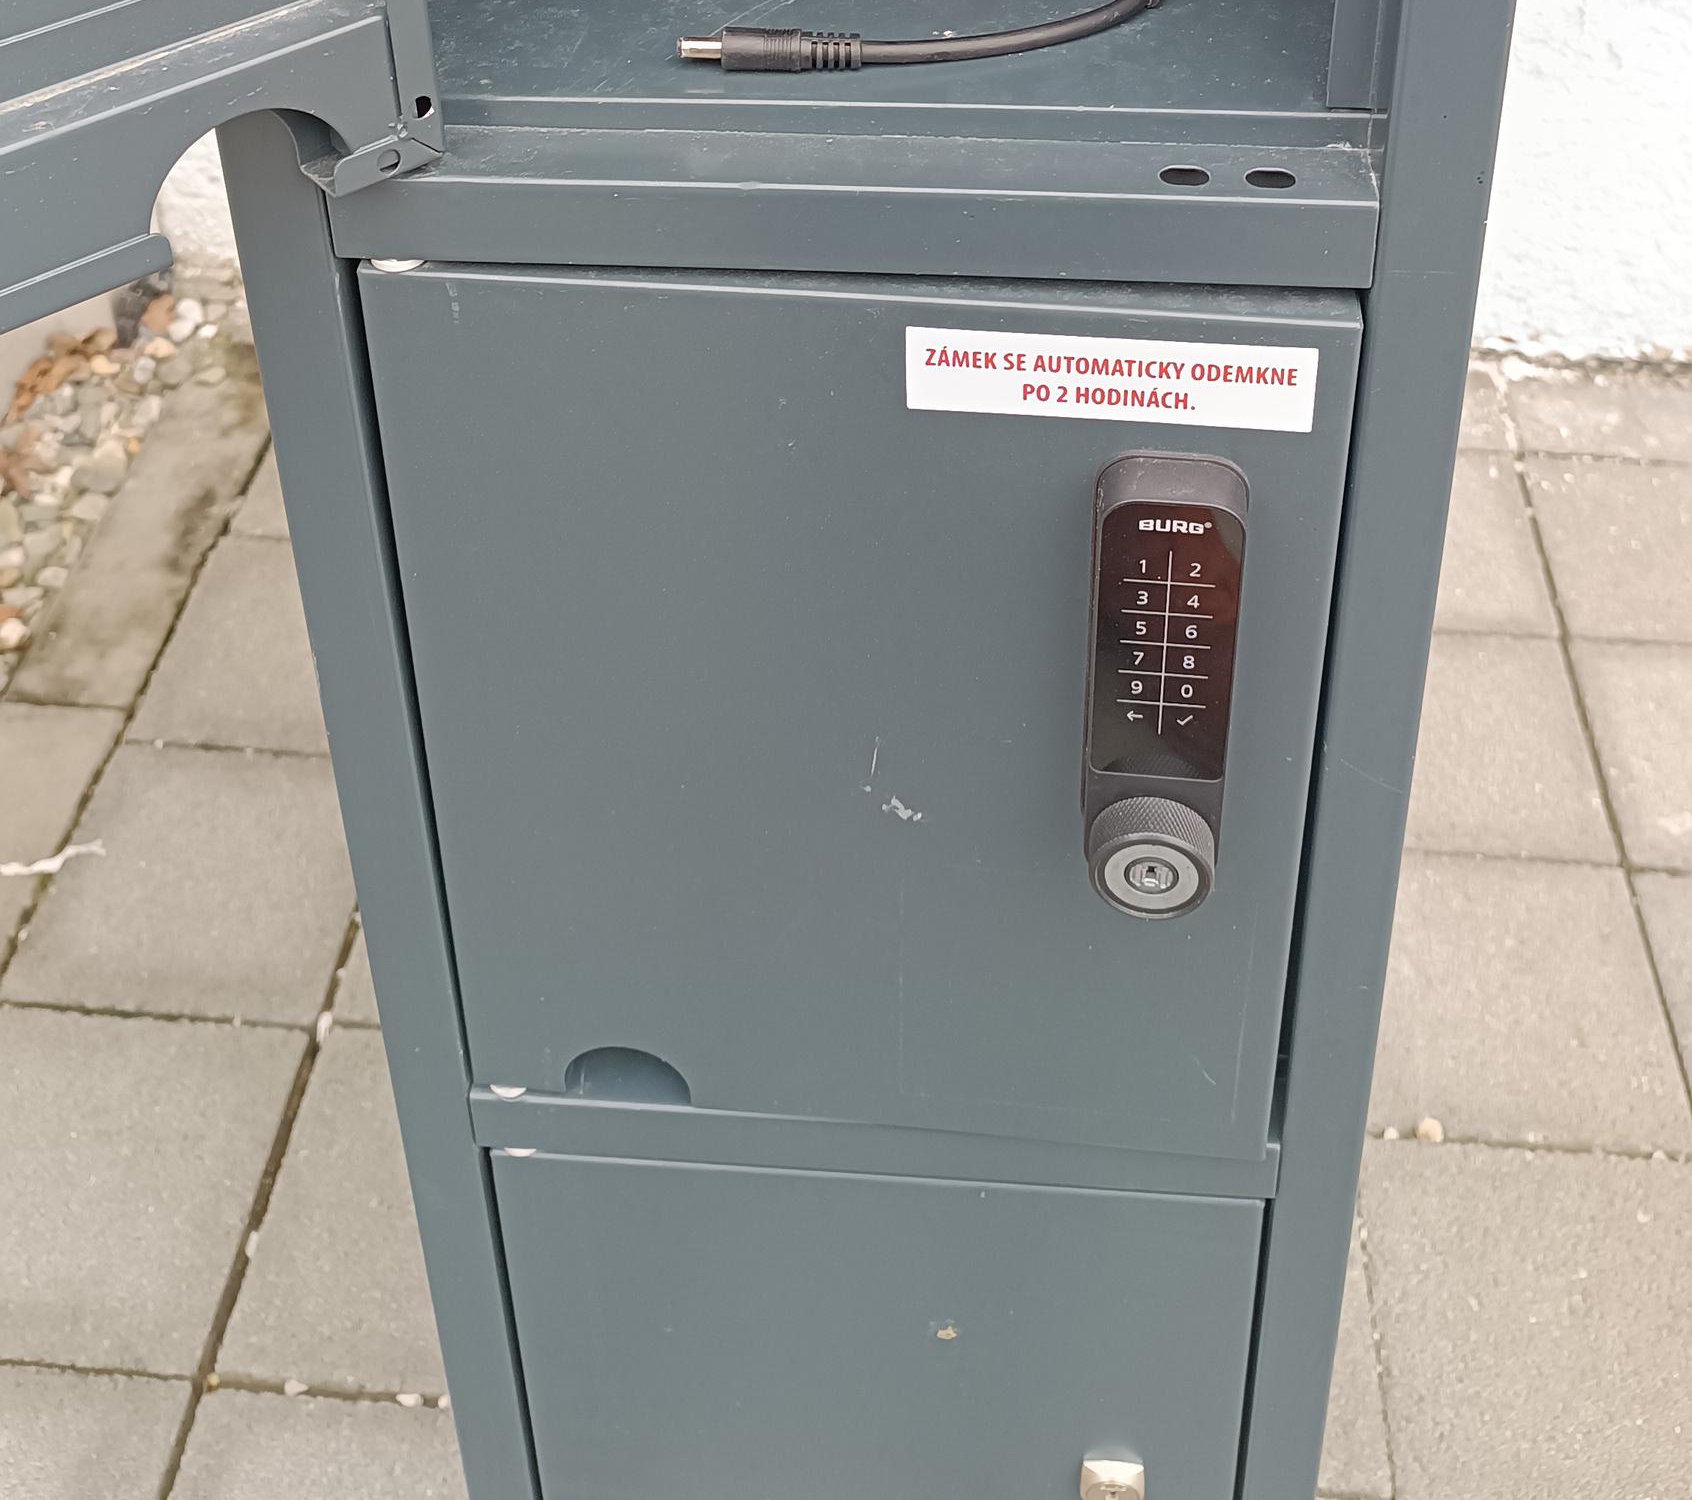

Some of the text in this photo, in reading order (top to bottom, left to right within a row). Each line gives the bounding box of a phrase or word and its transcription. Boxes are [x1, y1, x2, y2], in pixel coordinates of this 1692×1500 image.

[924, 345, 1298, 387] ZÁMEK SE AUTOMATICKY ODEMKNE
[1022, 383, 1196, 411] PO 2 HODINÁCH.
[1139, 559, 1202, 578] 1 2
[1136, 590, 1200, 609] 3 4
[1135, 620, 1198, 639] 5 6
[1132, 651, 1195, 670] 7 8
[1131, 680, 1193, 699] 9 0
